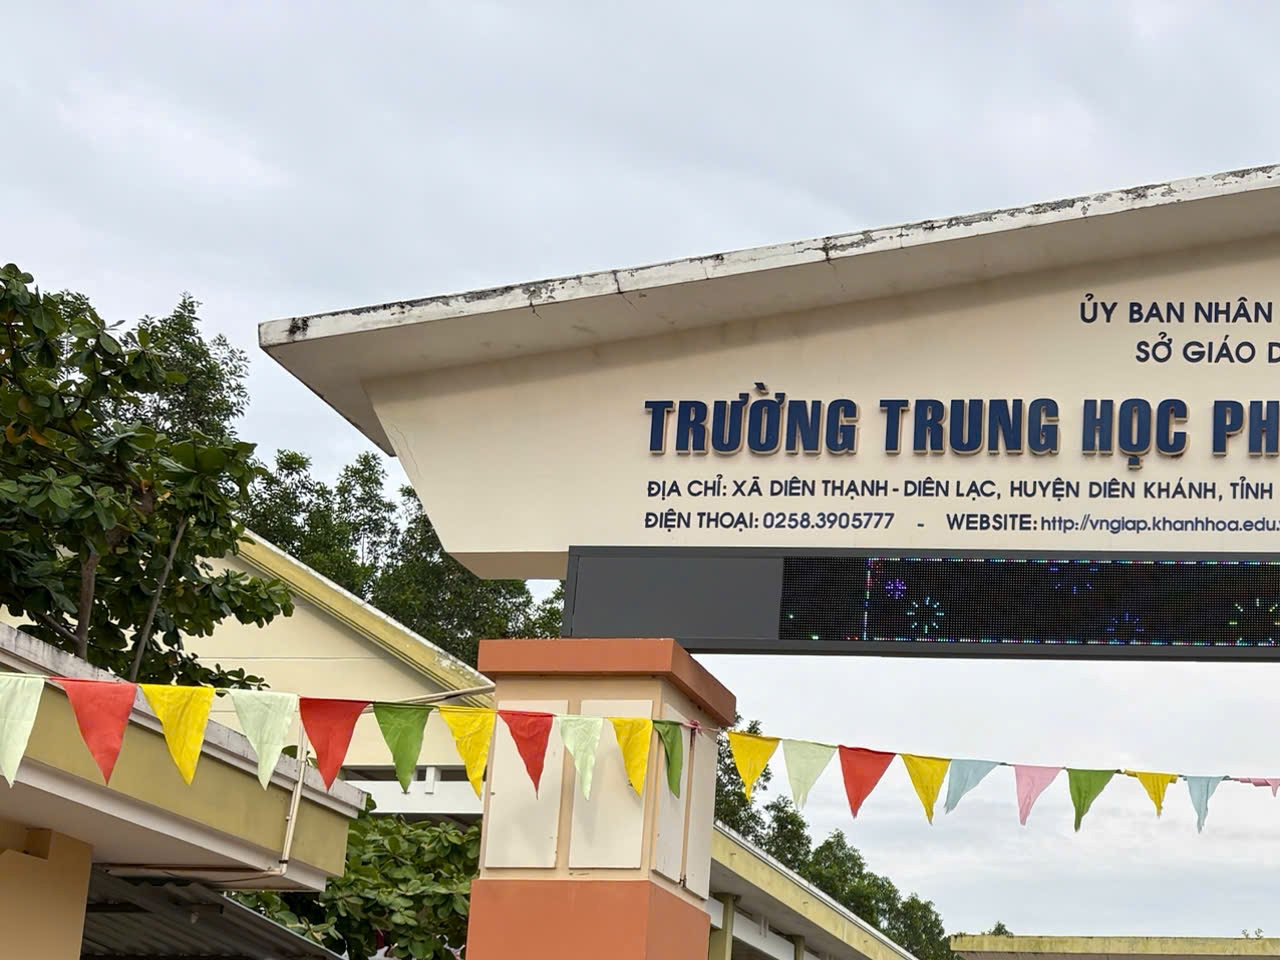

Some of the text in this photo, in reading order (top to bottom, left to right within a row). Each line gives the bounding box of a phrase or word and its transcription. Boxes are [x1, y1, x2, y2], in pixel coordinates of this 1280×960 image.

[1080, 292, 1119, 324] ỦY
[1128, 301, 1185, 324] BAN
[1194, 296, 1273, 324] NHÂN
[1135, 332, 1173, 363] SỞ
[1182, 334, 1256, 364] GIÁO
[644, 382, 857, 453] TRƯỜNG
[878, 397, 1060, 453] TRUNG
[1080, 397, 1188, 469] HỌC
[647, 480, 682, 501] ĐỊA
[687, 473, 727, 497] CHỈ:
[731, 475, 763, 497] XÃ
[770, 475, 816, 497] DIÊN
[821, 479, 889, 501] THẠNH
[903, 476, 950, 498] DIÊN
[955, 479, 1001, 501] LẠC,
[1010, 477, 1080, 502] HUYỆN
[1088, 477, 1136, 499] DIÊN
[1143, 476, 1223, 502] KHÁNH,
[1229, 475, 1273, 500] TỈNH
[644, 508, 692, 533] ĐIỆN
[696, 511, 759, 532] THOẠI:
[763, 512, 895, 530] 0258.3905777
[946, 513, 1038, 531] WEBSITE:
